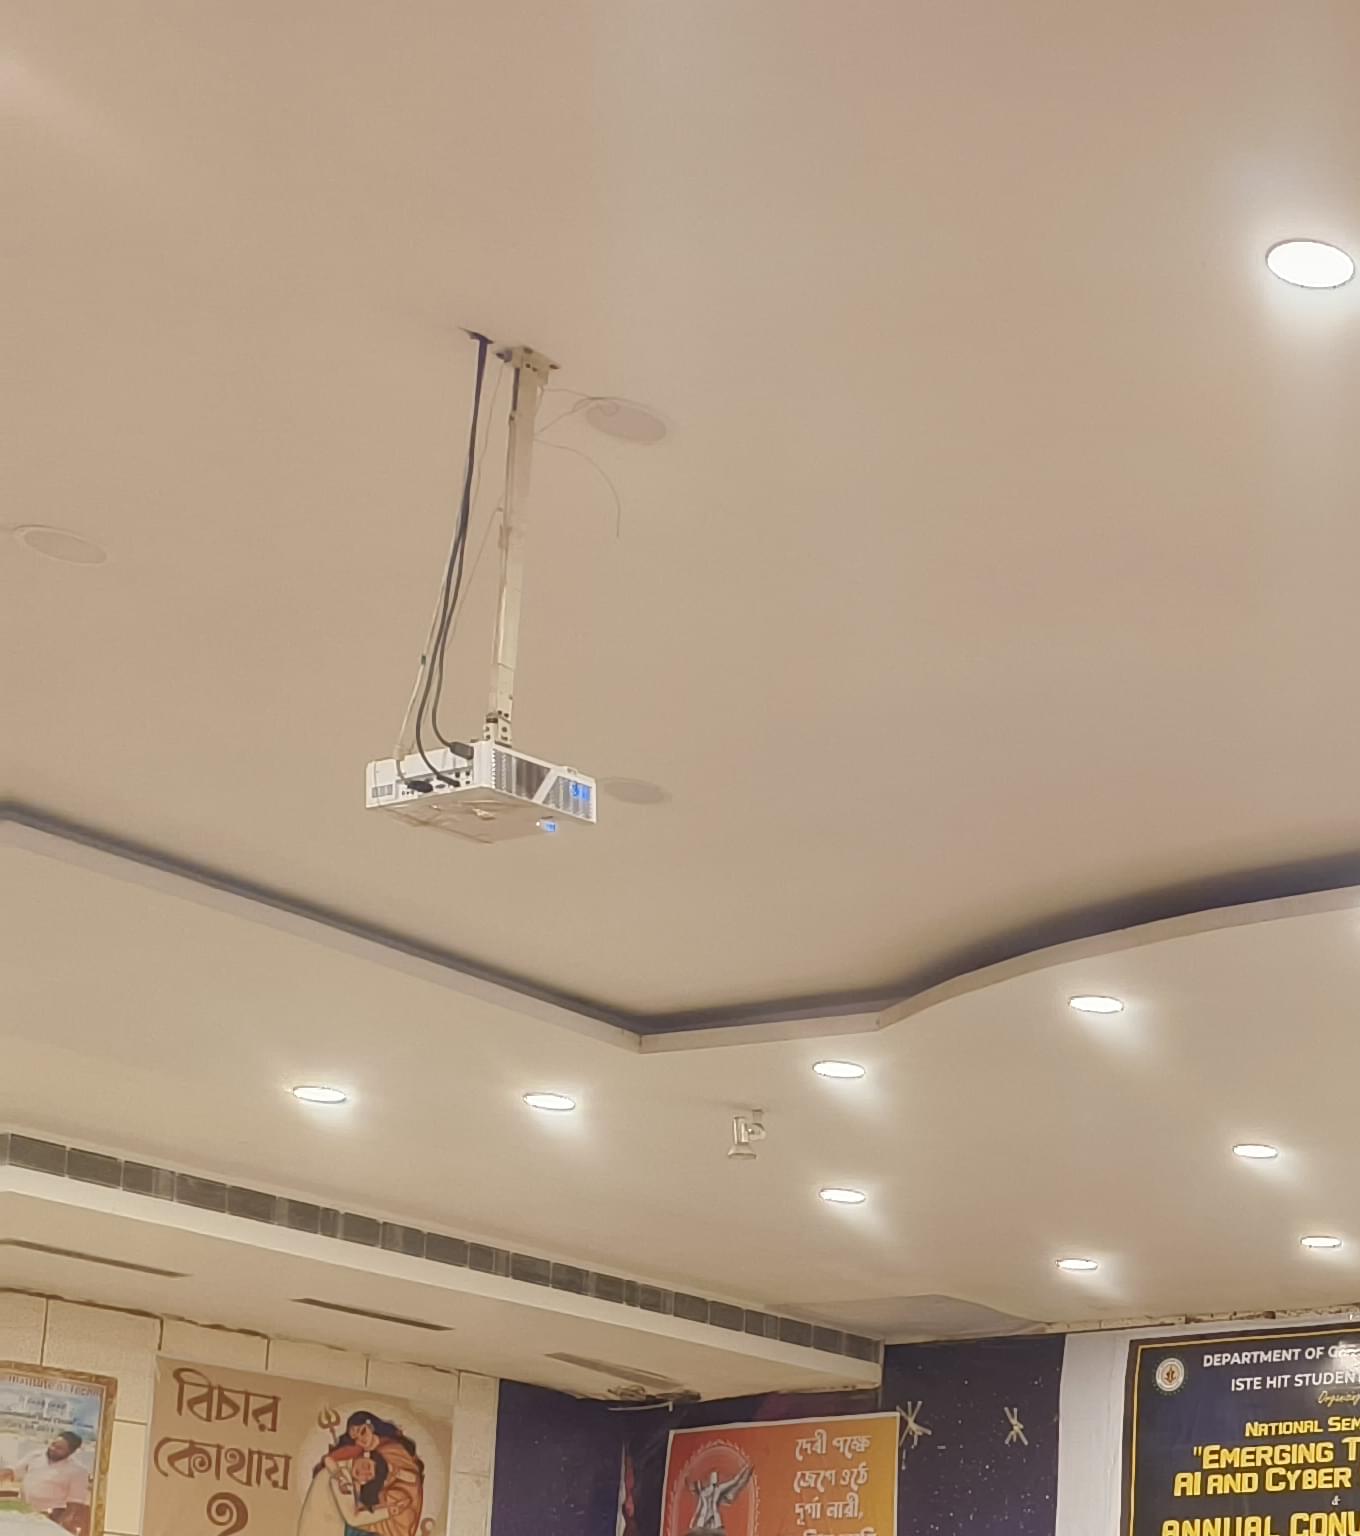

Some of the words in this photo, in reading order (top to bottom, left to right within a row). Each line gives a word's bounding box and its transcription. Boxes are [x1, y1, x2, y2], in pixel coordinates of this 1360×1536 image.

[1203, 1348, 1302, 1367] DEPARTMENT
[1305, 1347, 1326, 1361] OF
[1231, 1376, 1262, 1392] ISTE
[1266, 1374, 1291, 1390] HIT
[172, 1367, 281, 1434] বিচার
[795, 1429, 827, 1461] দেবী
[832, 1434, 873, 1460] পক্ষে
[153, 1434, 293, 1491] কোথায়
[794, 1469, 836, 1494] জেগে
[839, 1462, 870, 1492] ওঠে
[1173, 1471, 1202, 1497] AI
[1206, 1471, 1259, 1494] AND
[1265, 1466, 1352, 1492] CYBER
